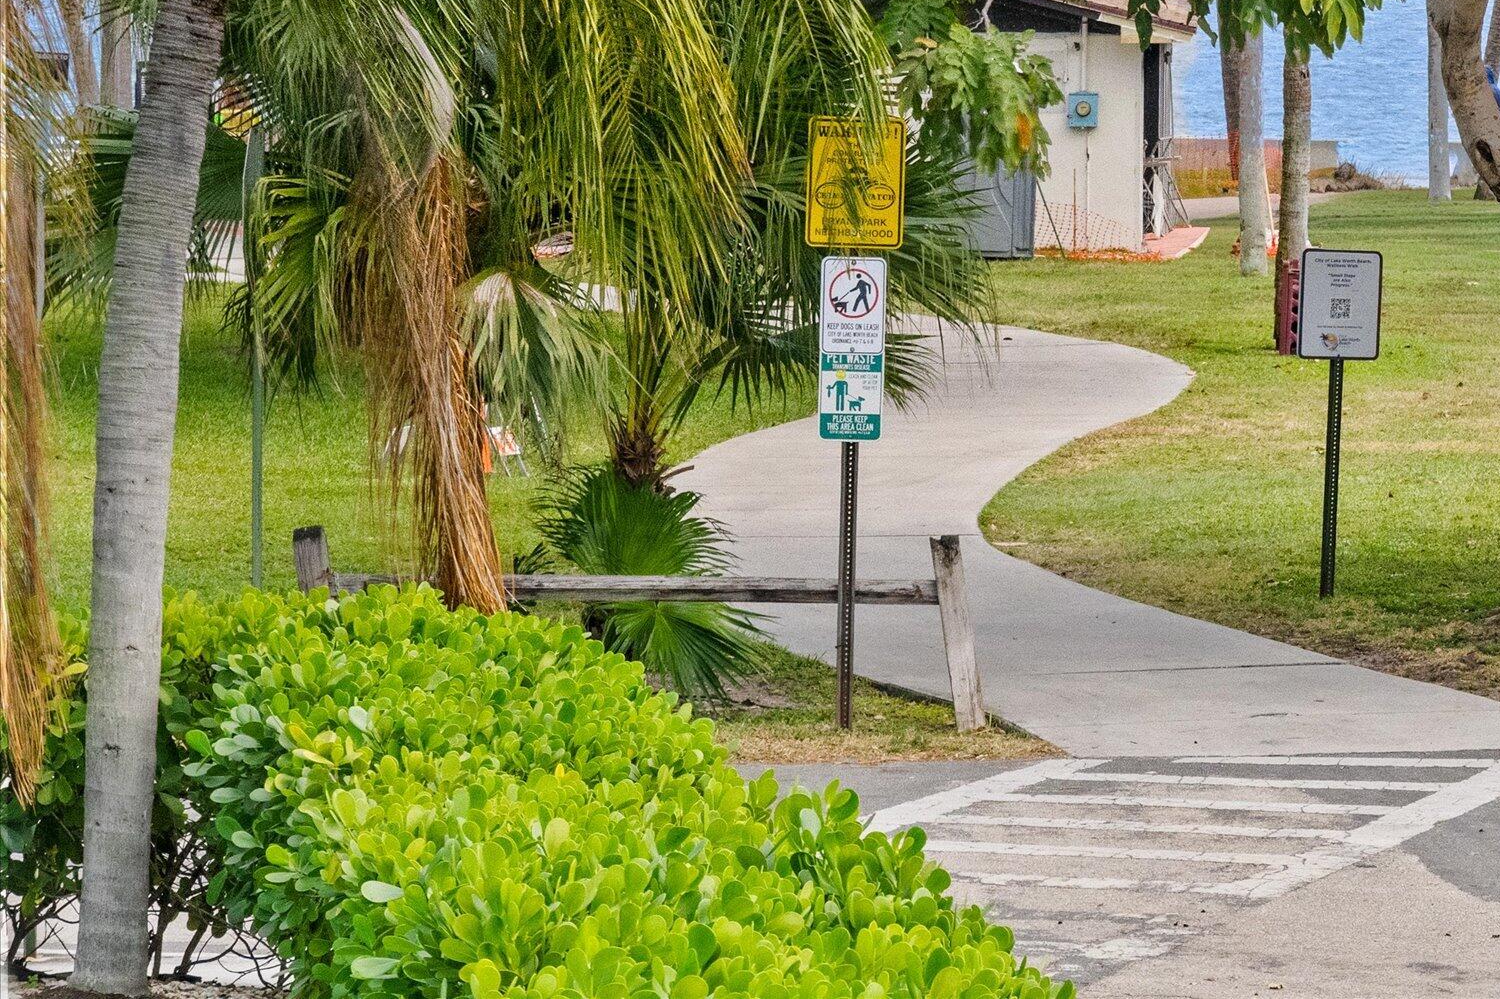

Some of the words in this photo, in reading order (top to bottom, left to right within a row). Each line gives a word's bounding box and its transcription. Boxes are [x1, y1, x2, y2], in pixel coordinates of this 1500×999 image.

[827, 354, 842, 363] PET
[847, 354, 876, 364] WASTE
[832, 415, 853, 423] PLEASE
[856, 423, 874, 431] CLEAN
